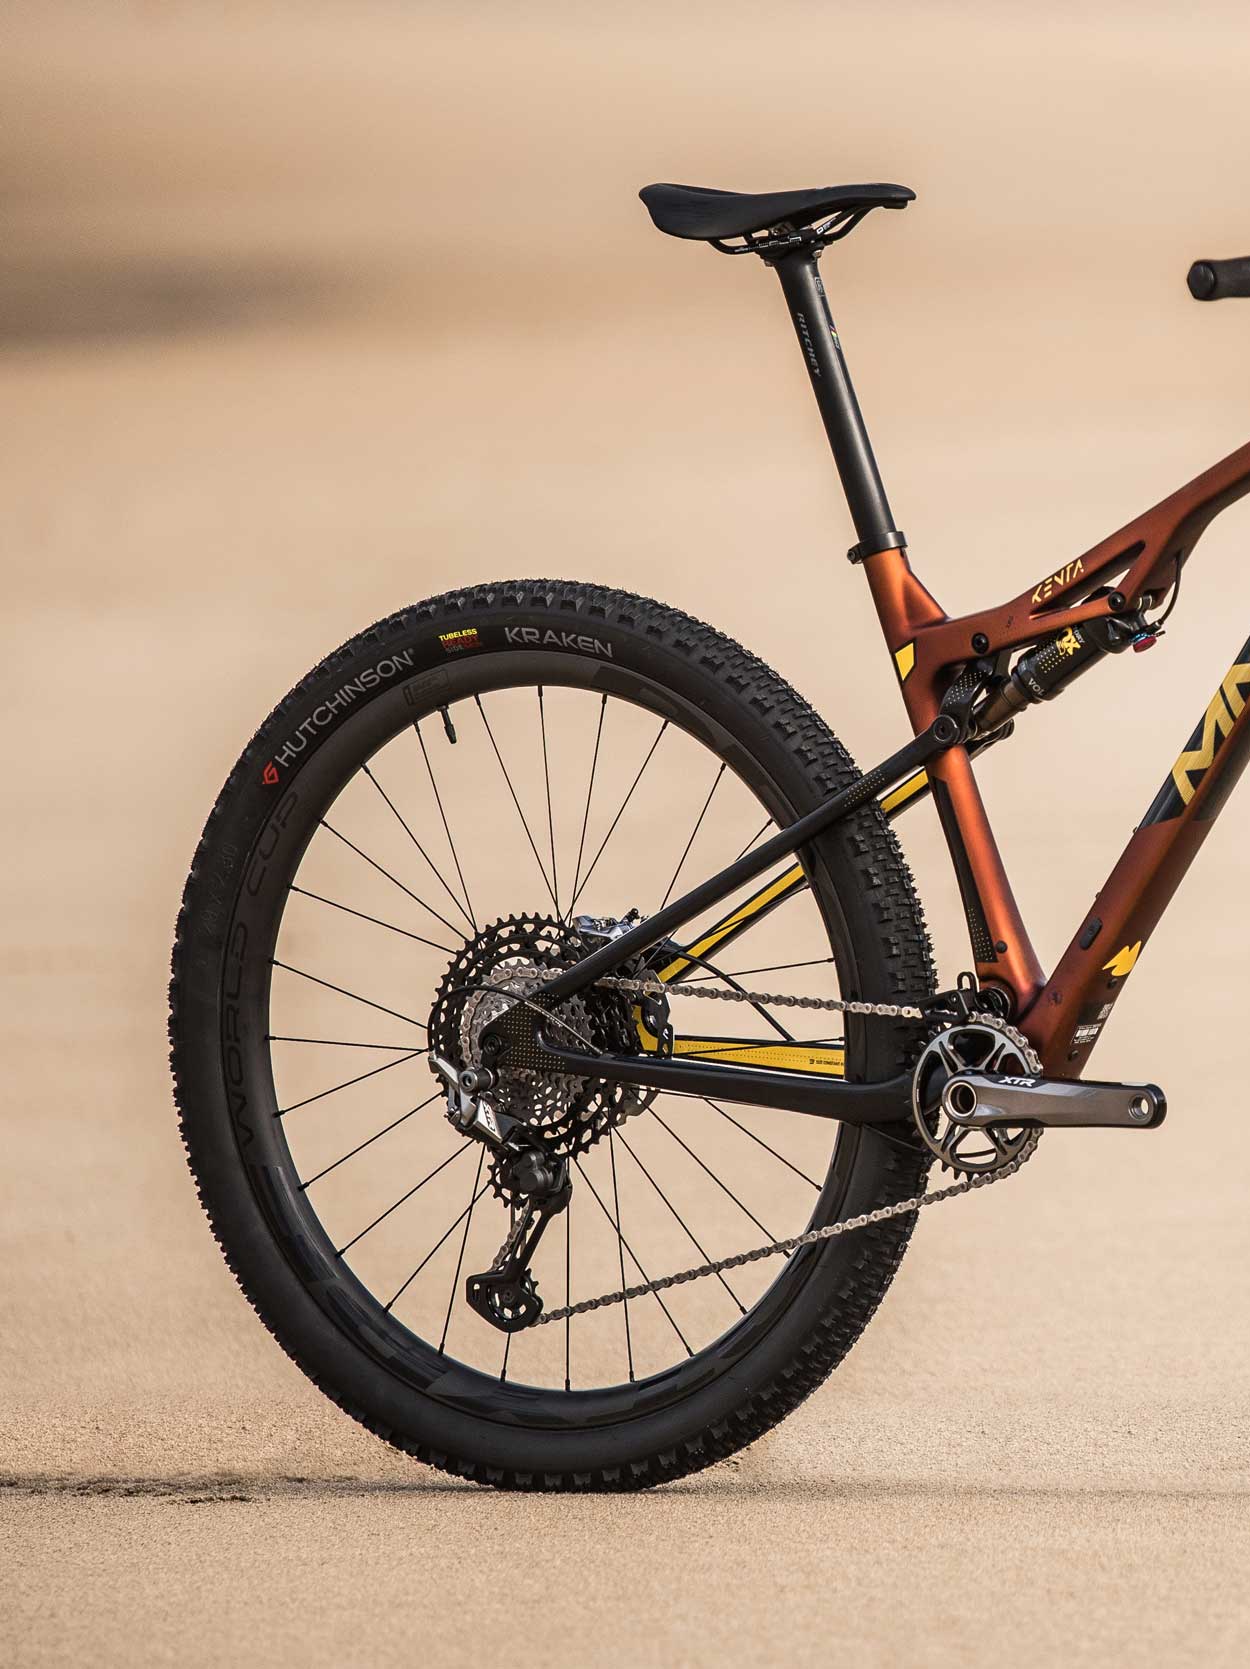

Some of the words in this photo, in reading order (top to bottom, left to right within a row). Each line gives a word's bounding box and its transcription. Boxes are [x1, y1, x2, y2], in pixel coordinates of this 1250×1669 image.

[797, 312, 821, 376] RITCHEY
[1031, 559, 1085, 604] KENTA
[438, 628, 478, 641] TUBELESS
[504, 627, 613, 658] KRAKEN
[274, 650, 415, 767] HUTCHINSON
[998, 1076, 1037, 1088] XTR
